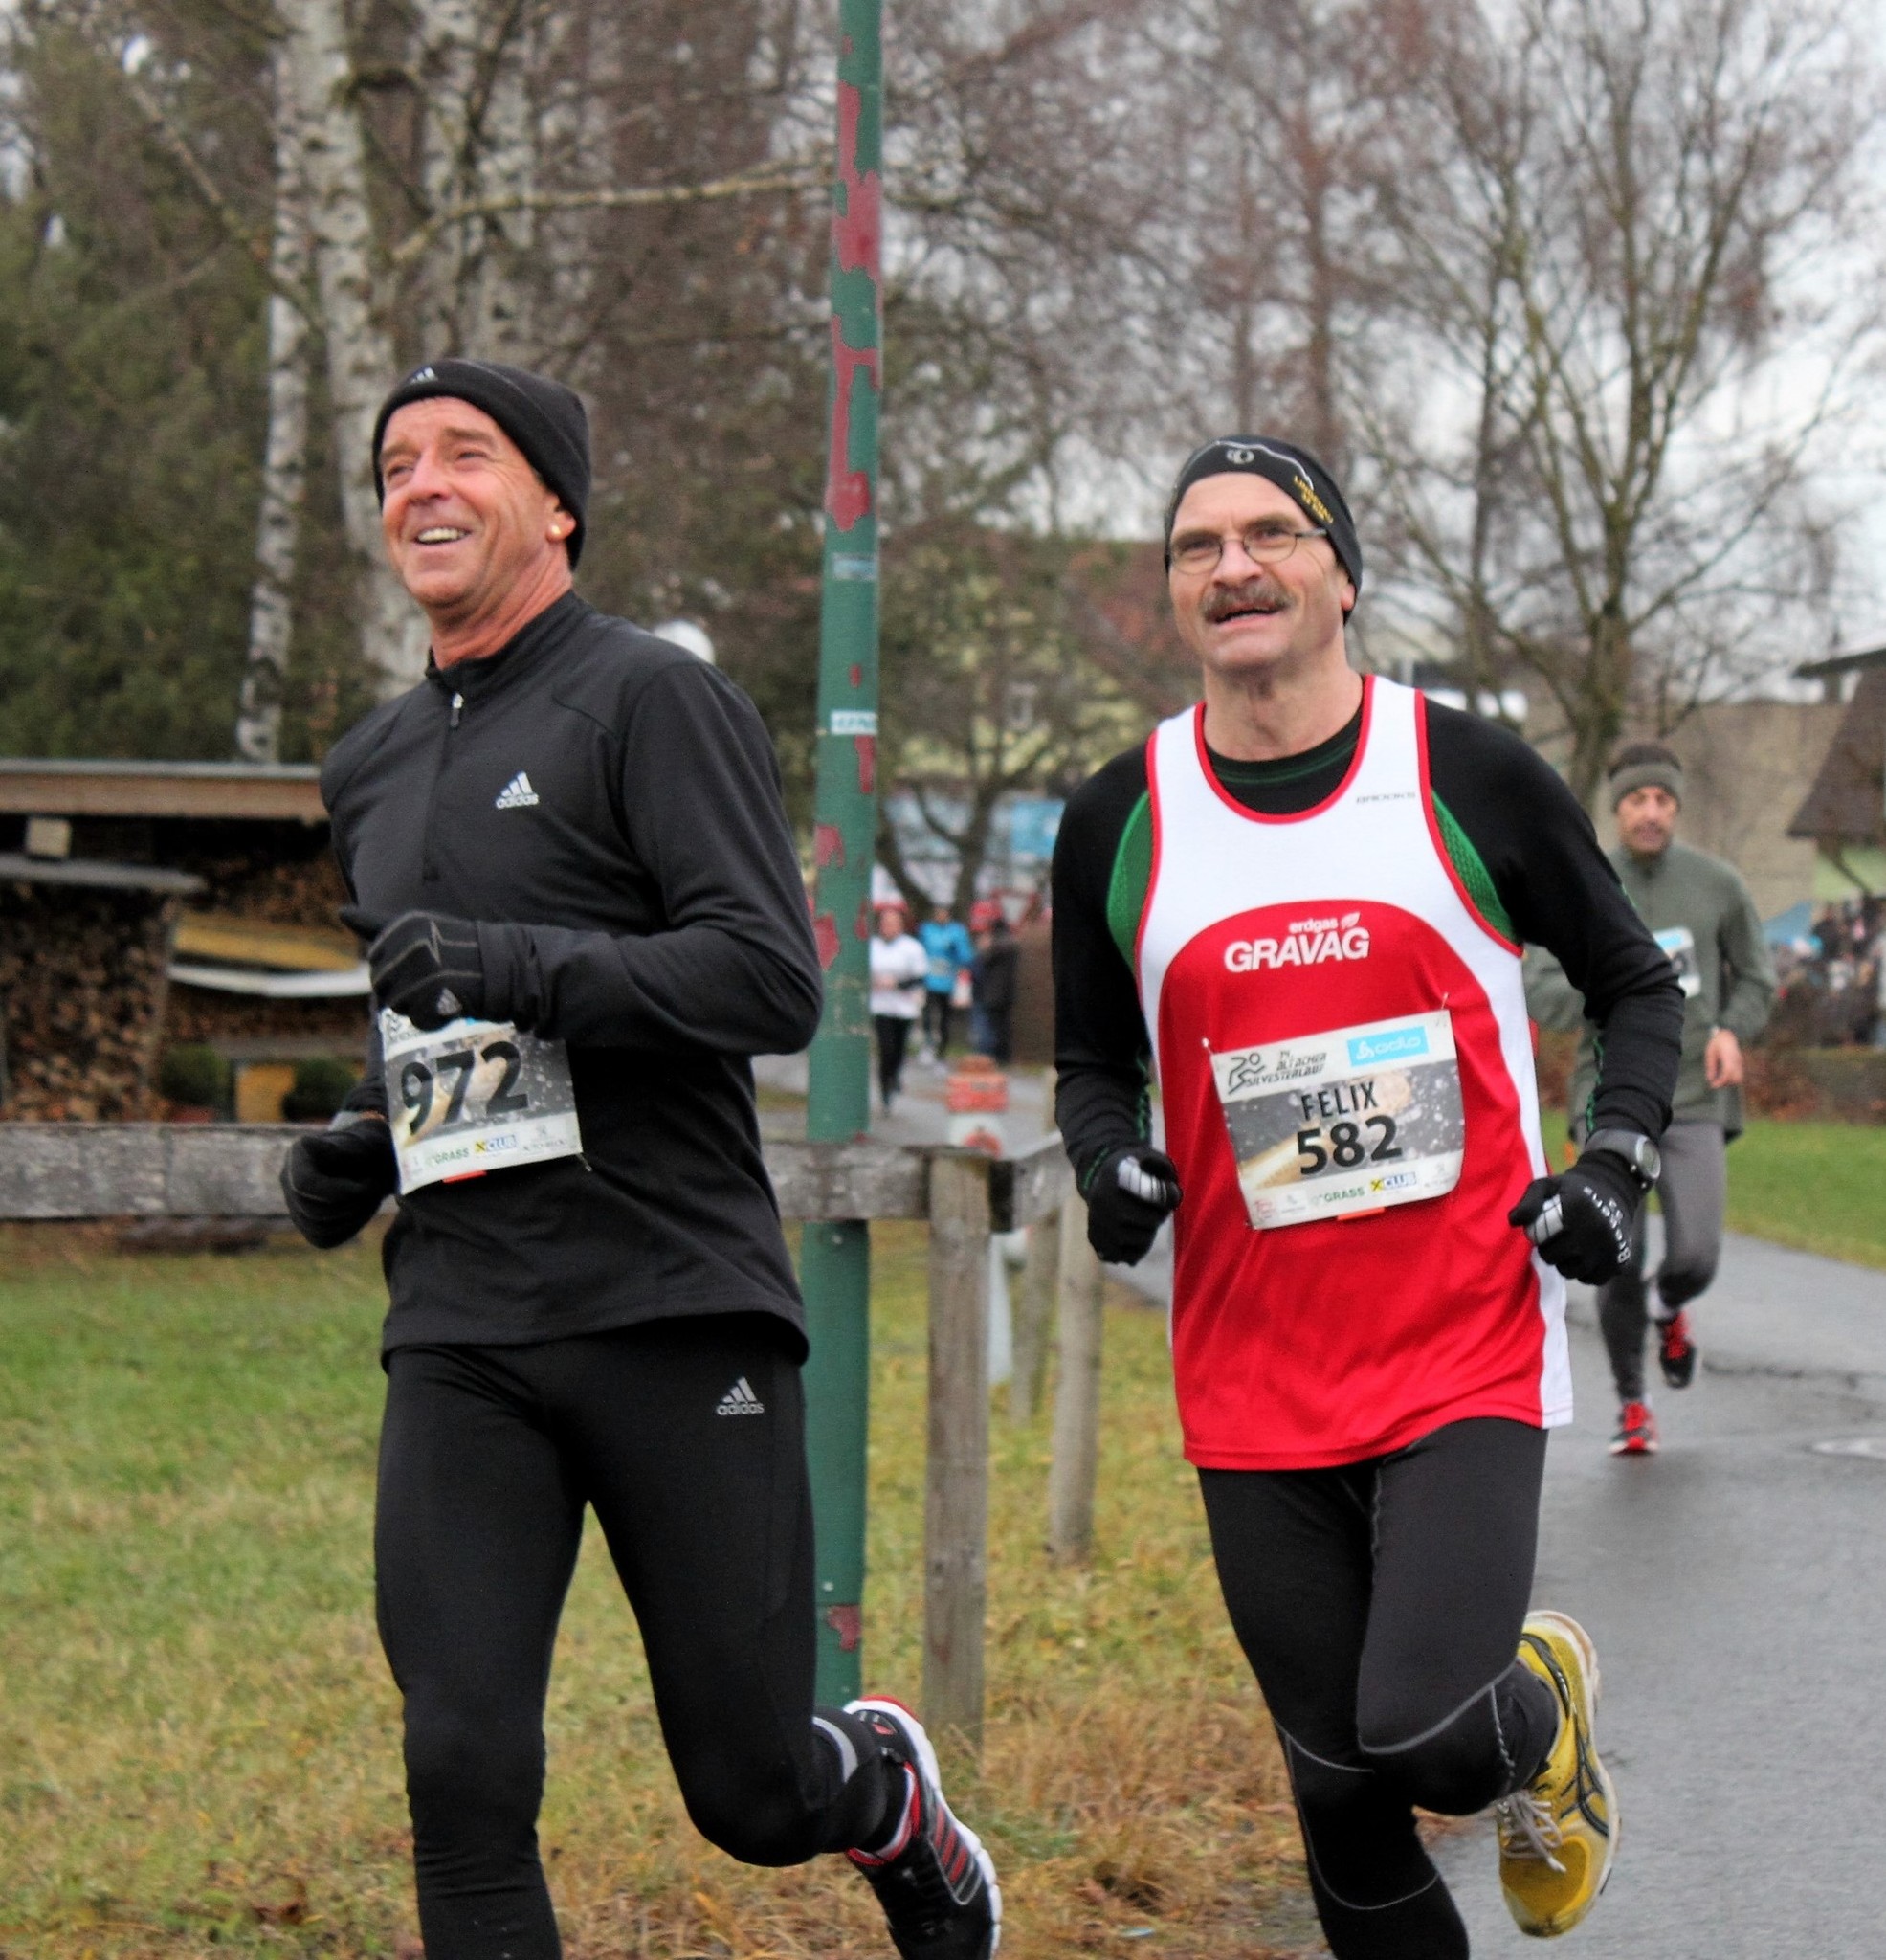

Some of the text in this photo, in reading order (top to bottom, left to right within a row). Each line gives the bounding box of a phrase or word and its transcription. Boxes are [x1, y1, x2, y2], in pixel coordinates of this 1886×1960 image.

[495, 793, 539, 811] adidas
[1288, 917, 1339, 934] erdgas
[1224, 926, 1370, 973] GRAVAG
[401, 1041, 528, 1136] 972
[1301, 1081, 1379, 1121] FELIX
[1297, 1115, 1403, 1175] 582
[435, 1147, 470, 1166] GRASS
[1324, 1186, 1365, 1204] GRASS
[716, 1402, 765, 1416] adidas
